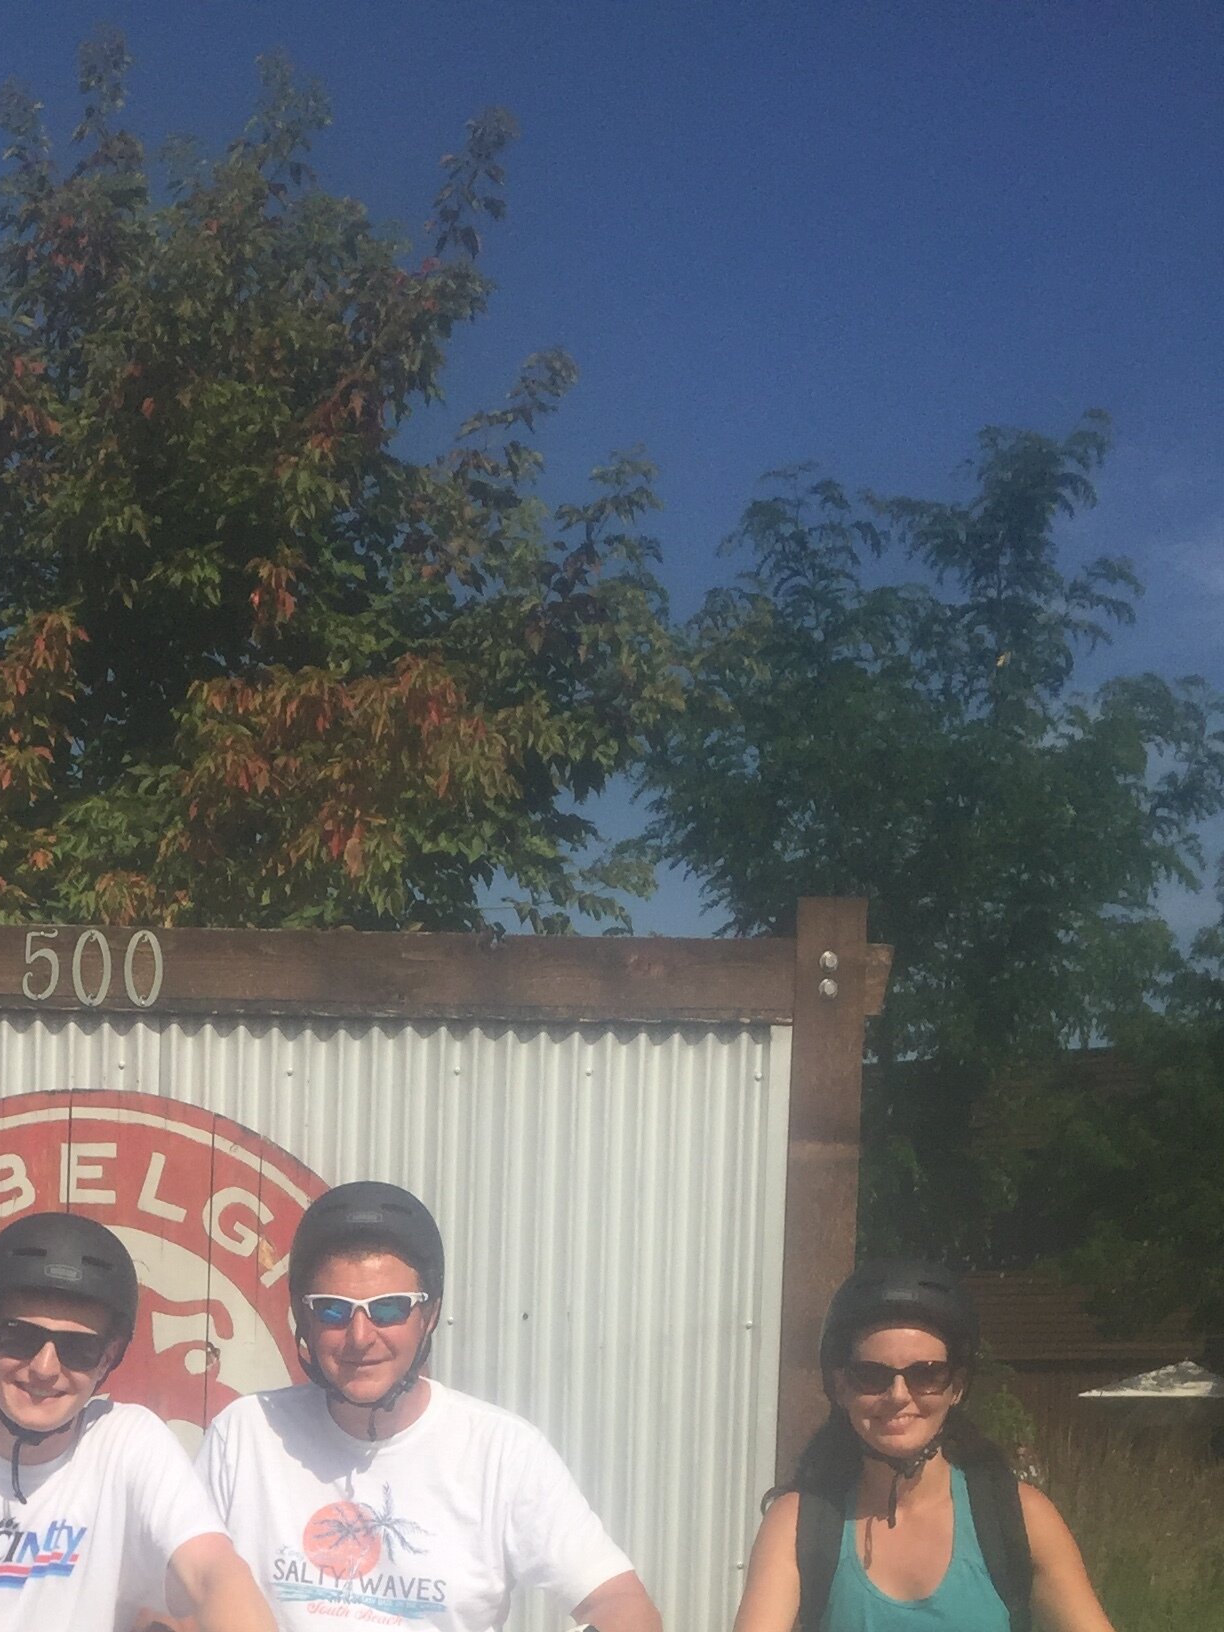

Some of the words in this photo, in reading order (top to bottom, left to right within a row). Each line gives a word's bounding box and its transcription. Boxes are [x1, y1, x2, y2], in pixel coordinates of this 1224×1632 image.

[23, 929, 163, 1007] 500
[273, 1559, 347, 1589] SALTY
[358, 1573, 447, 1602] WAVES
